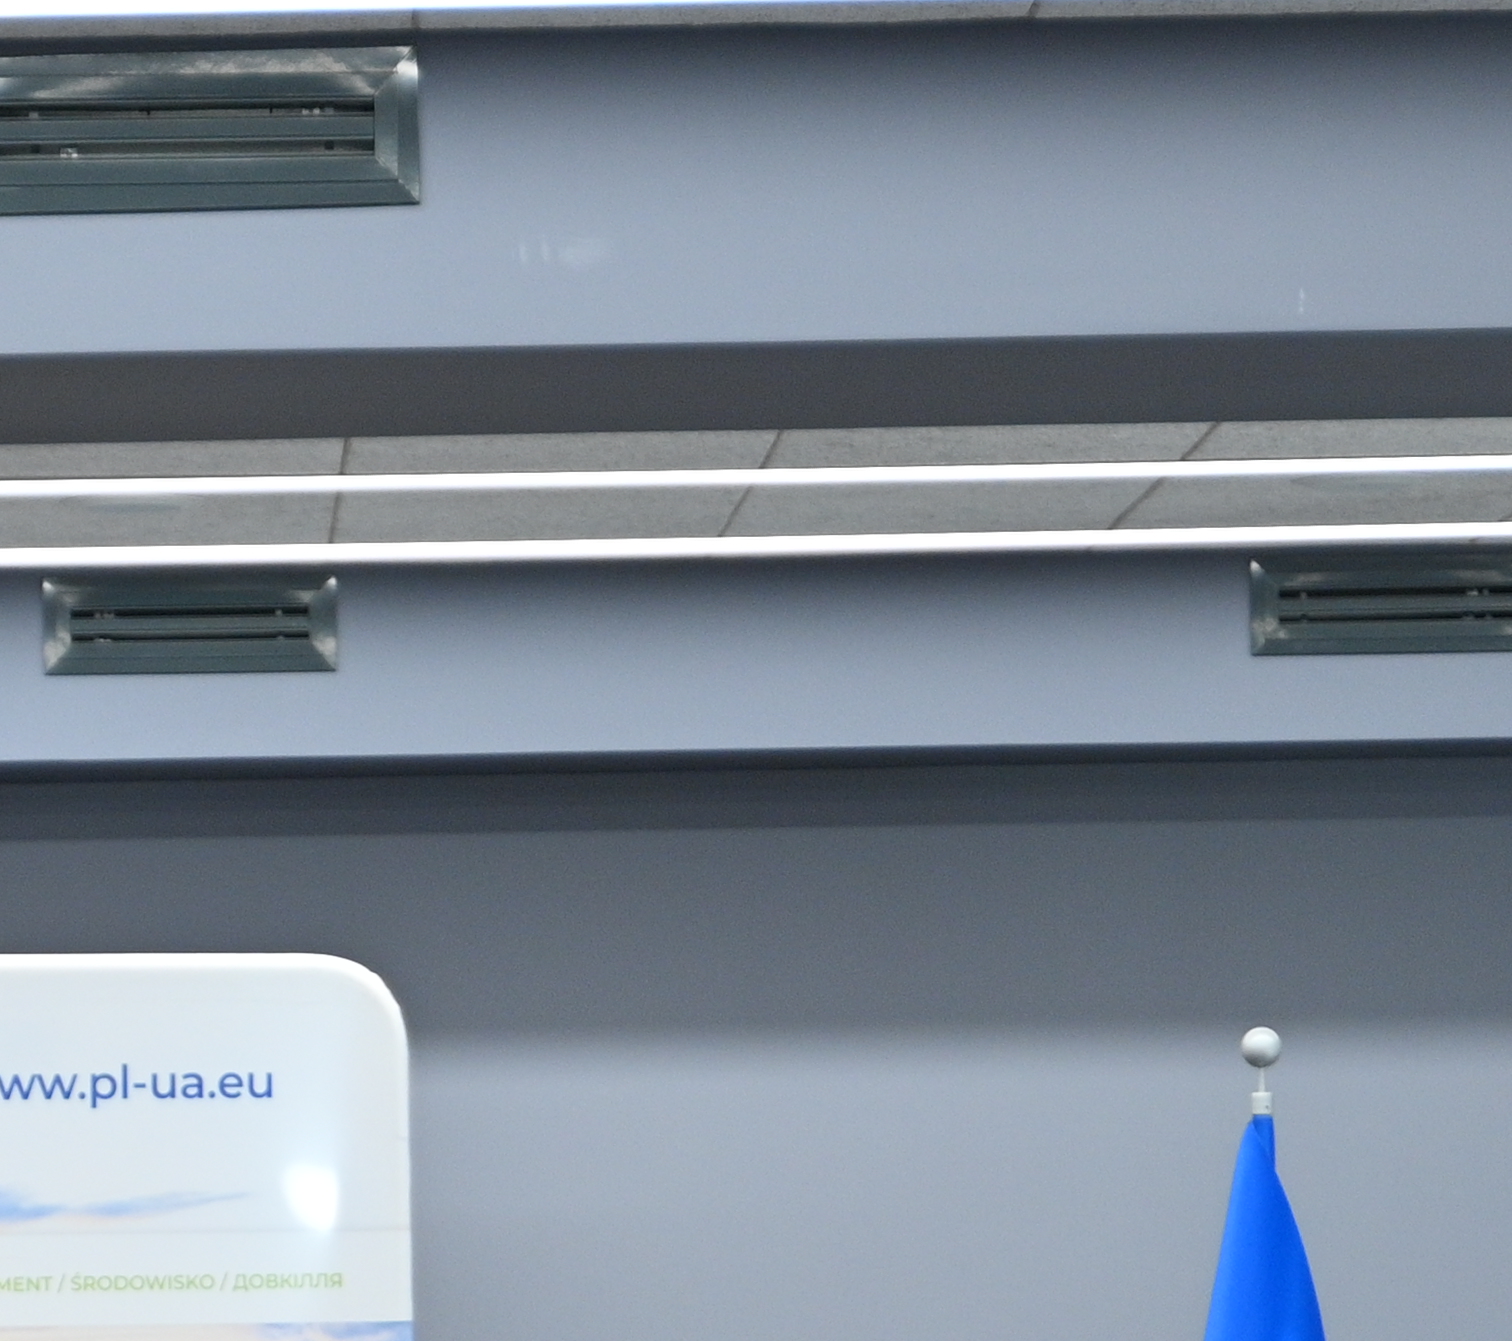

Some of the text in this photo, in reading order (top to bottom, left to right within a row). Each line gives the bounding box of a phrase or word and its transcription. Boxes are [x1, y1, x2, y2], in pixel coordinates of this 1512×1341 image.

[57, 1274, 67, 1294] /
[70, 1272, 215, 1292] ŚRODOWISKO
[219, 1272, 229, 1292] /
[232, 1272, 344, 1292] ДОВКІЛЛЯ
